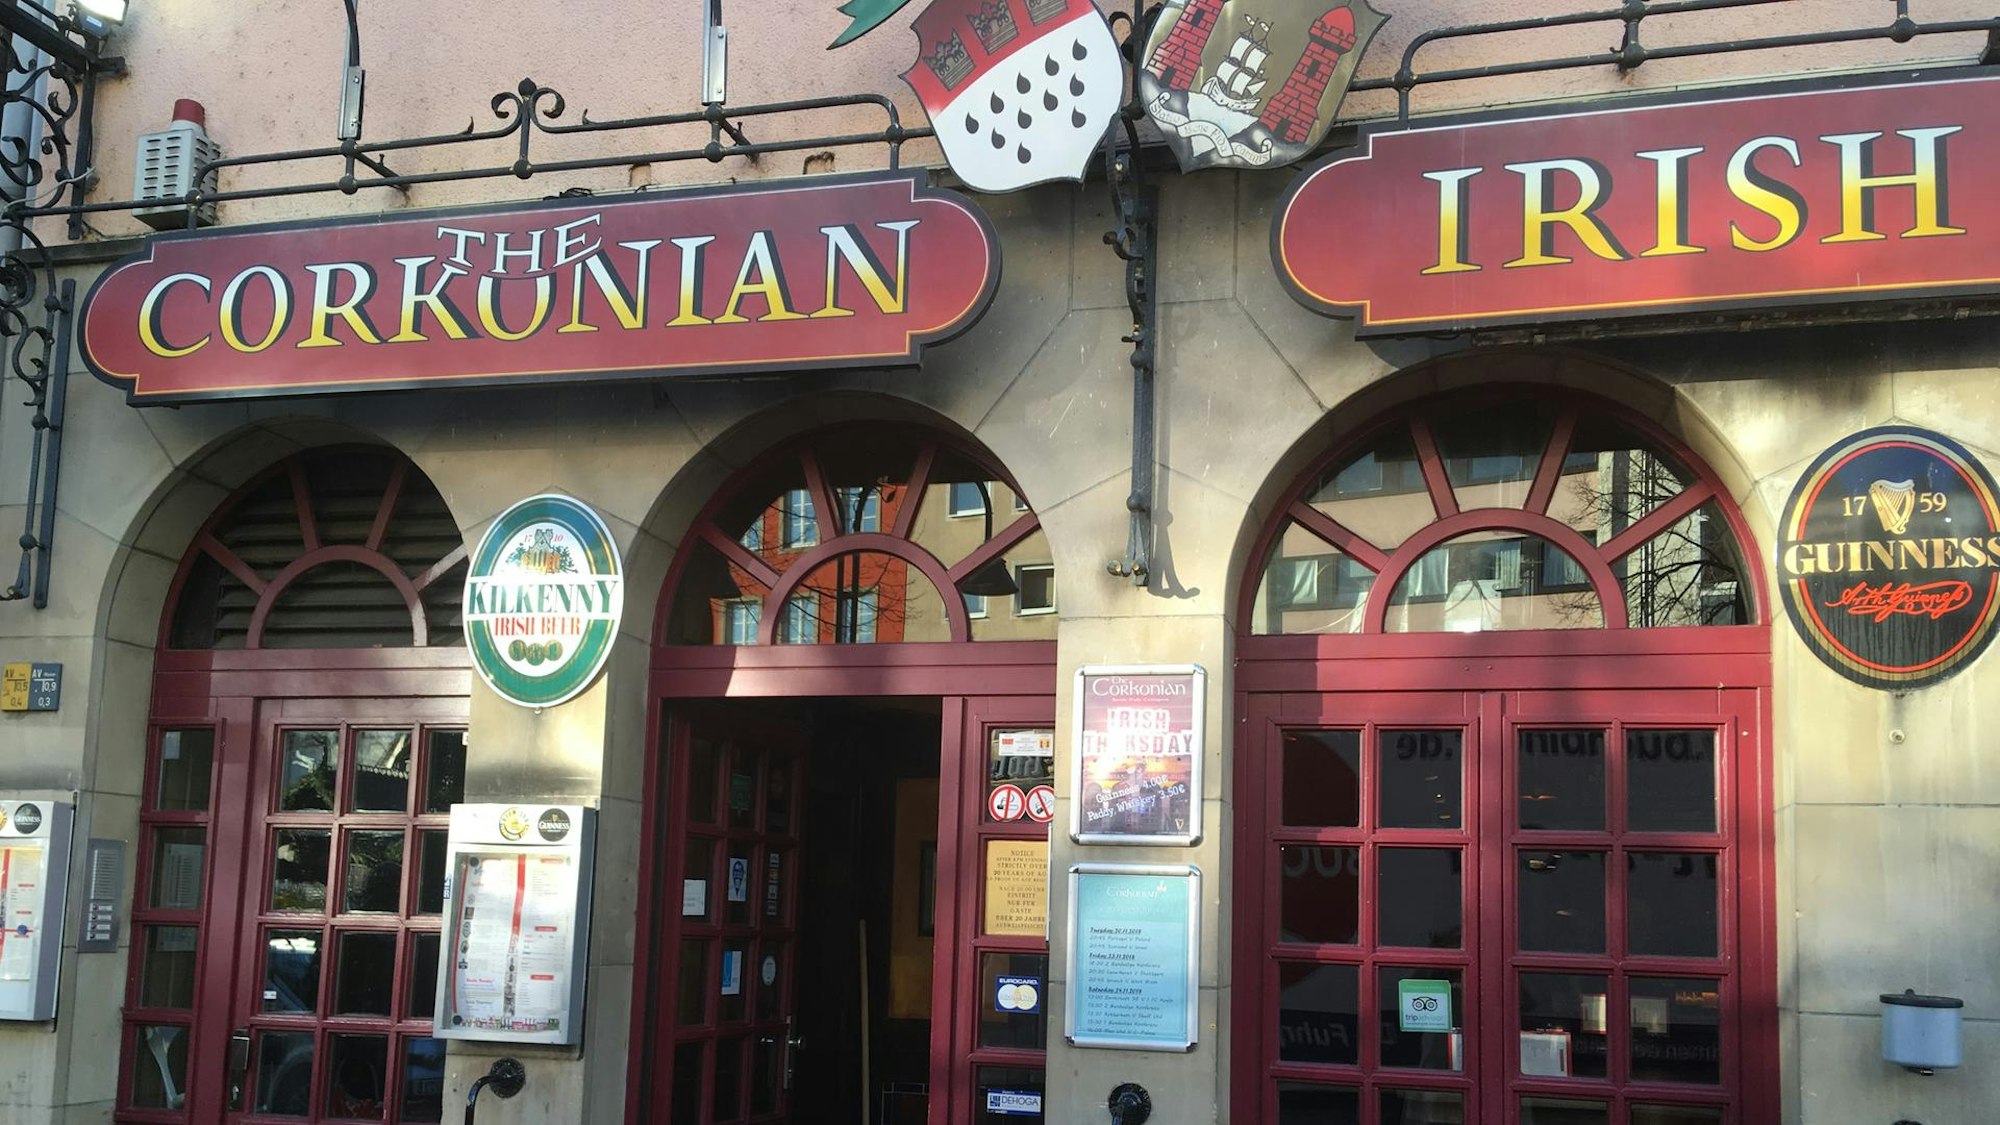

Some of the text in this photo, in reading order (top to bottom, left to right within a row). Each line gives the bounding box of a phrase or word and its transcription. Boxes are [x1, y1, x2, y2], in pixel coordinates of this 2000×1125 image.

[1420, 126, 1966, 275] IRISH
[437, 214, 602, 274] THE
[138, 219, 922, 358] CORKONIAN
[1843, 492, 1947, 517] 17 59
[467, 580, 619, 615] KILKENNY
[494, 617, 580, 636] IRISH BEER
[1092, 677, 1186, 697] Corkonian
[1111, 710, 1167, 730] IRISH
[1085, 733, 1192, 754] THRSDAY
[1096, 784, 1140, 804] Guinness
[1116, 794, 1156, 812] Whiskey
[1001, 1095, 1039, 1106] DEHOGA
